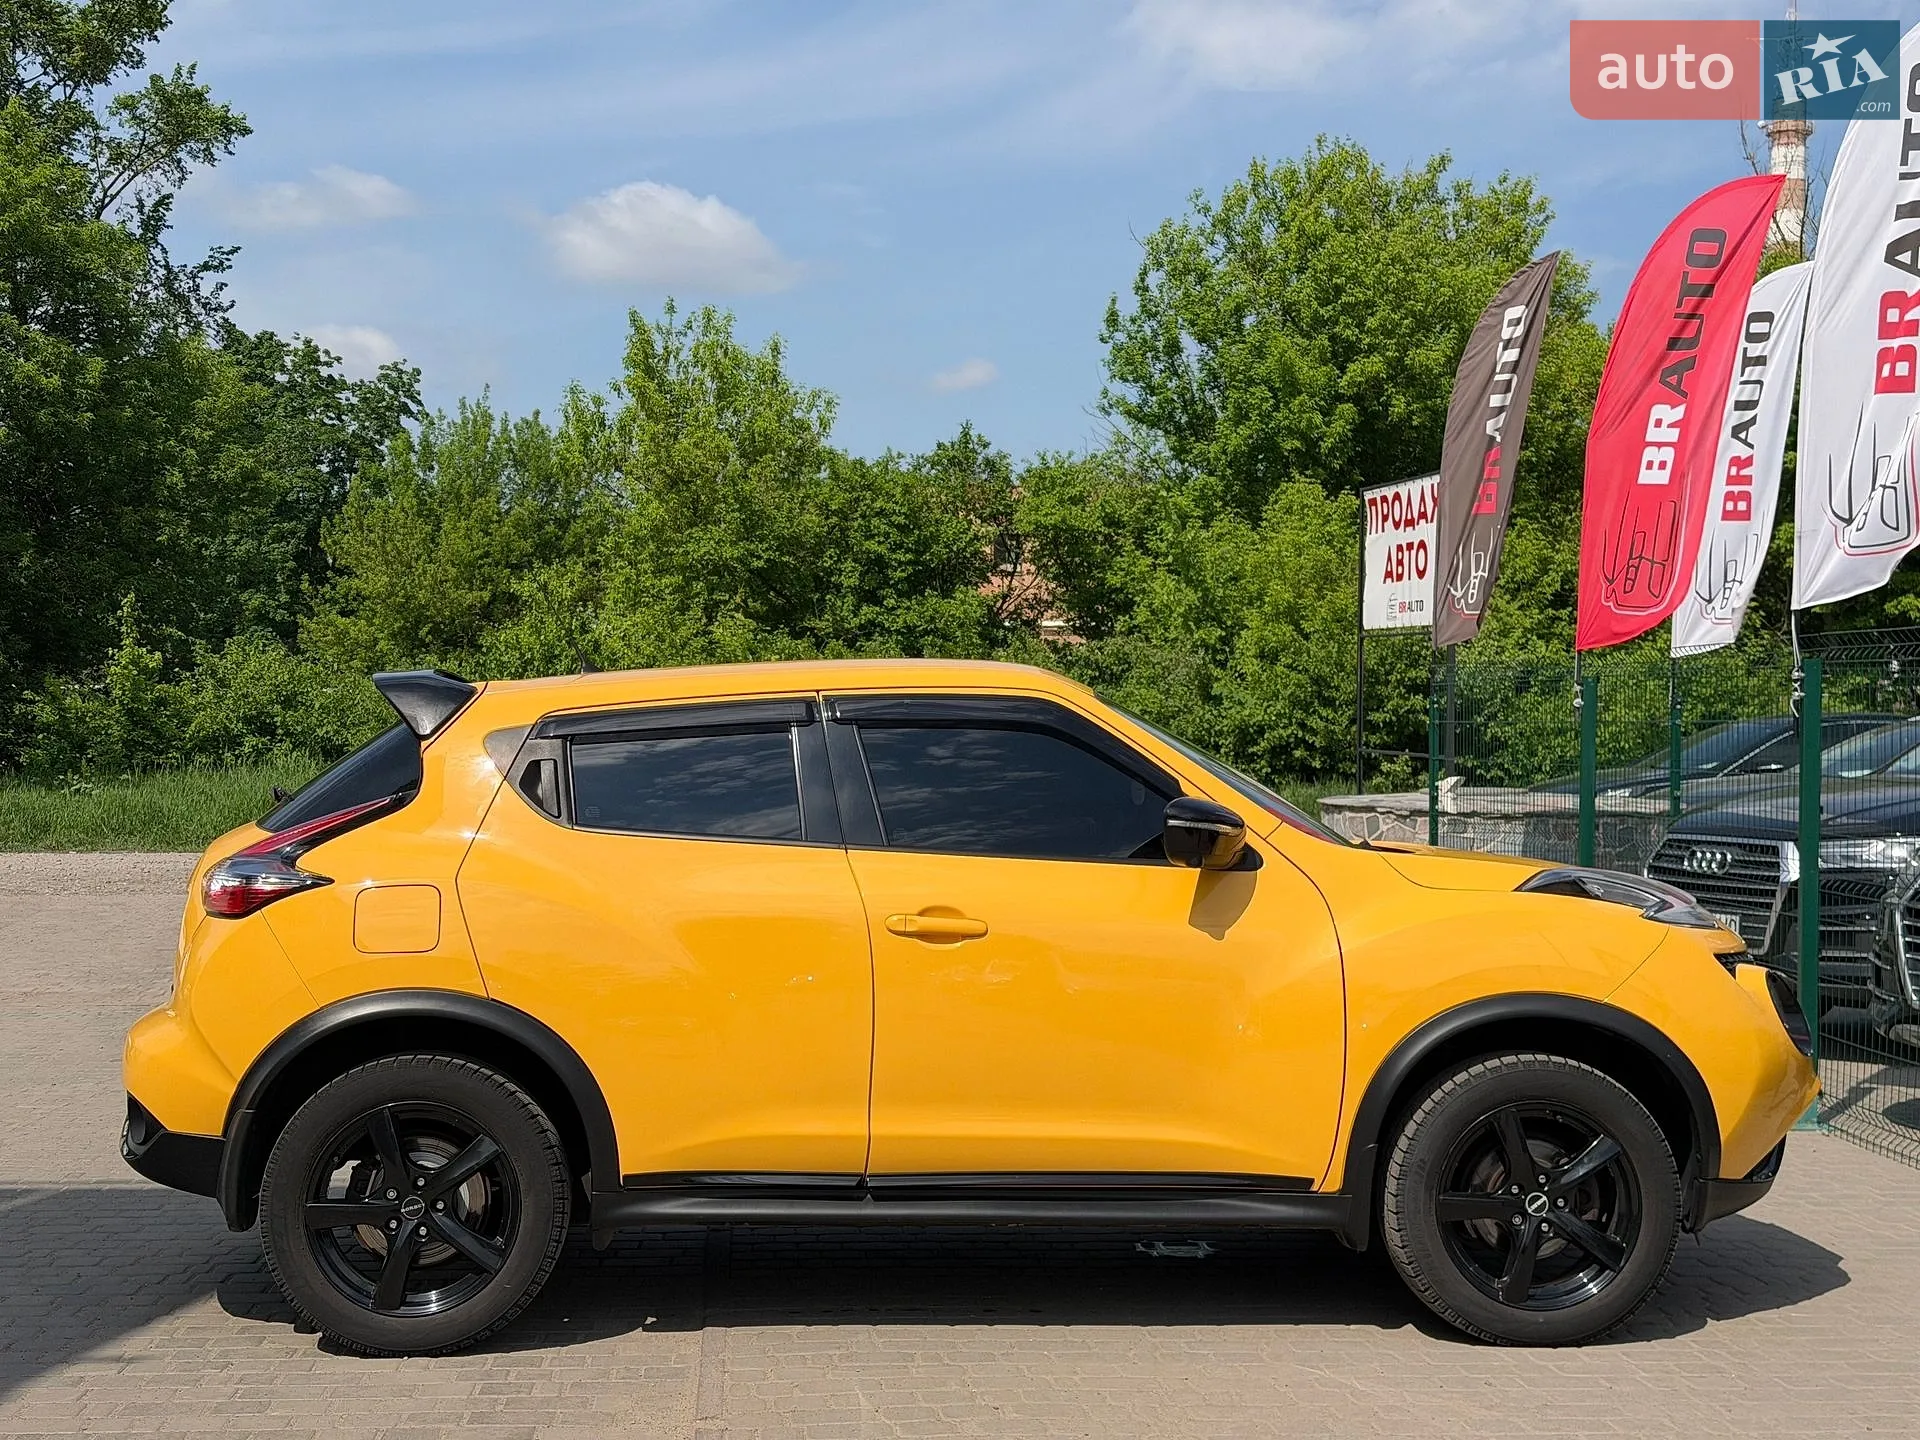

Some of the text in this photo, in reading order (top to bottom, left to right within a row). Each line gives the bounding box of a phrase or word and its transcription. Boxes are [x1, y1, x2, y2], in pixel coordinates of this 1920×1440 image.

[1636, 227, 1728, 485] BRAUTO
[1720, 310, 1775, 522] BRAUTO
[1383, 539, 1428, 584] АВТО
